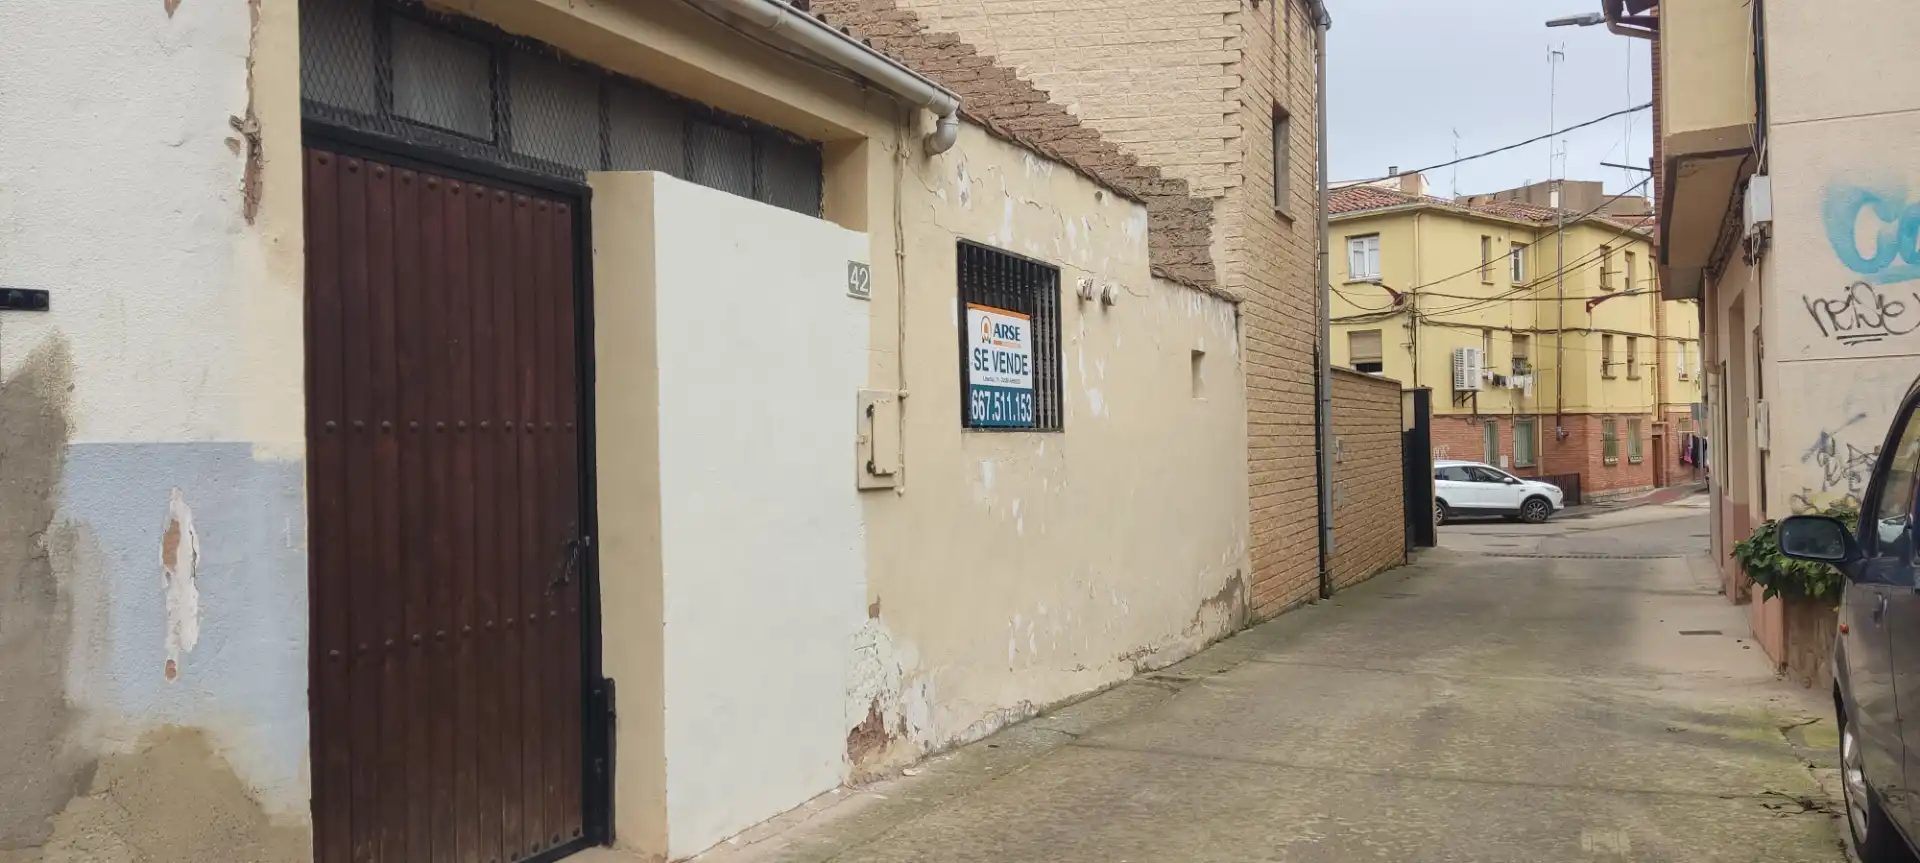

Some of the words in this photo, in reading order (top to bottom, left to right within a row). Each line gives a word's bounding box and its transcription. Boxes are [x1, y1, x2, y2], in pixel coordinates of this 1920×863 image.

[850, 265, 869, 292] 42
[993, 323, 1021, 341] ARSE
[974, 348, 989, 371] SE
[992, 351, 1028, 375] VENDE
[971, 389, 1032, 422] 667.511.153
